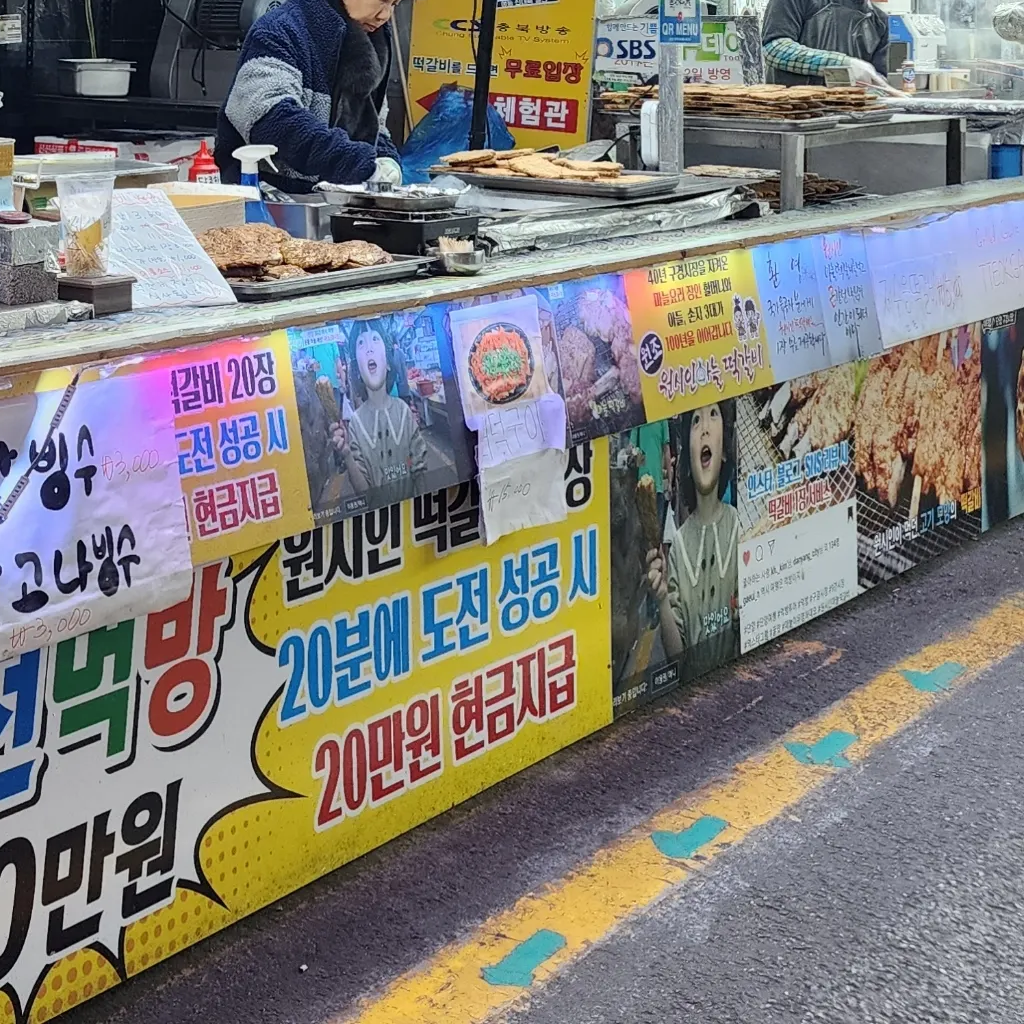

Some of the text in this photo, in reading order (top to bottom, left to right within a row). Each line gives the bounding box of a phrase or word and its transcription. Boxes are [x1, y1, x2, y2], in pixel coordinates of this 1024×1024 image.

[495, 34, 515, 42] able
[517, 35, 532, 43] TV
[533, 36, 570, 44] System
[496, 22, 572, 37] 충북방송
[640, 22, 658, 34] 기쁨
[662, 23, 698, 36] QR MENU
[617, 39, 656, 59] SBS
[413, 56, 462, 74] 떡갈비를
[466, 62, 499, 78] 드면
[504, 58, 584, 84] 무료입장
[707, 67, 731, 80] 방영
[493, 96, 569, 128] 체험관
[647, 255, 729, 285] 40년 구경시장을 지켜온
[652, 277, 732, 307] 마늘요리 장인 할머니와
[667, 301, 724, 328] 아들, 손자 3대가
[664, 322, 733, 352] 100년을 이어갑니다
[640, 337, 663, 371] 원조
[722, 344, 764, 384] 떡갈비
[170, 351, 275, 413] 갈비 20장
[219, 413, 288, 466] 성공 시
[194, 474, 279, 534] 현금지급
[874, 522, 903, 558] 원시인이
[920, 508, 934, 533] 고기
[936, 500, 957, 526] 모양의
[961, 487, 981, 513] 떡갈비
[278, 530, 597, 722] 20분에 도전 성공 시
[703, 606, 730, 636] 맛있어요
[315, 636, 576, 827] 20만원 현금지급
